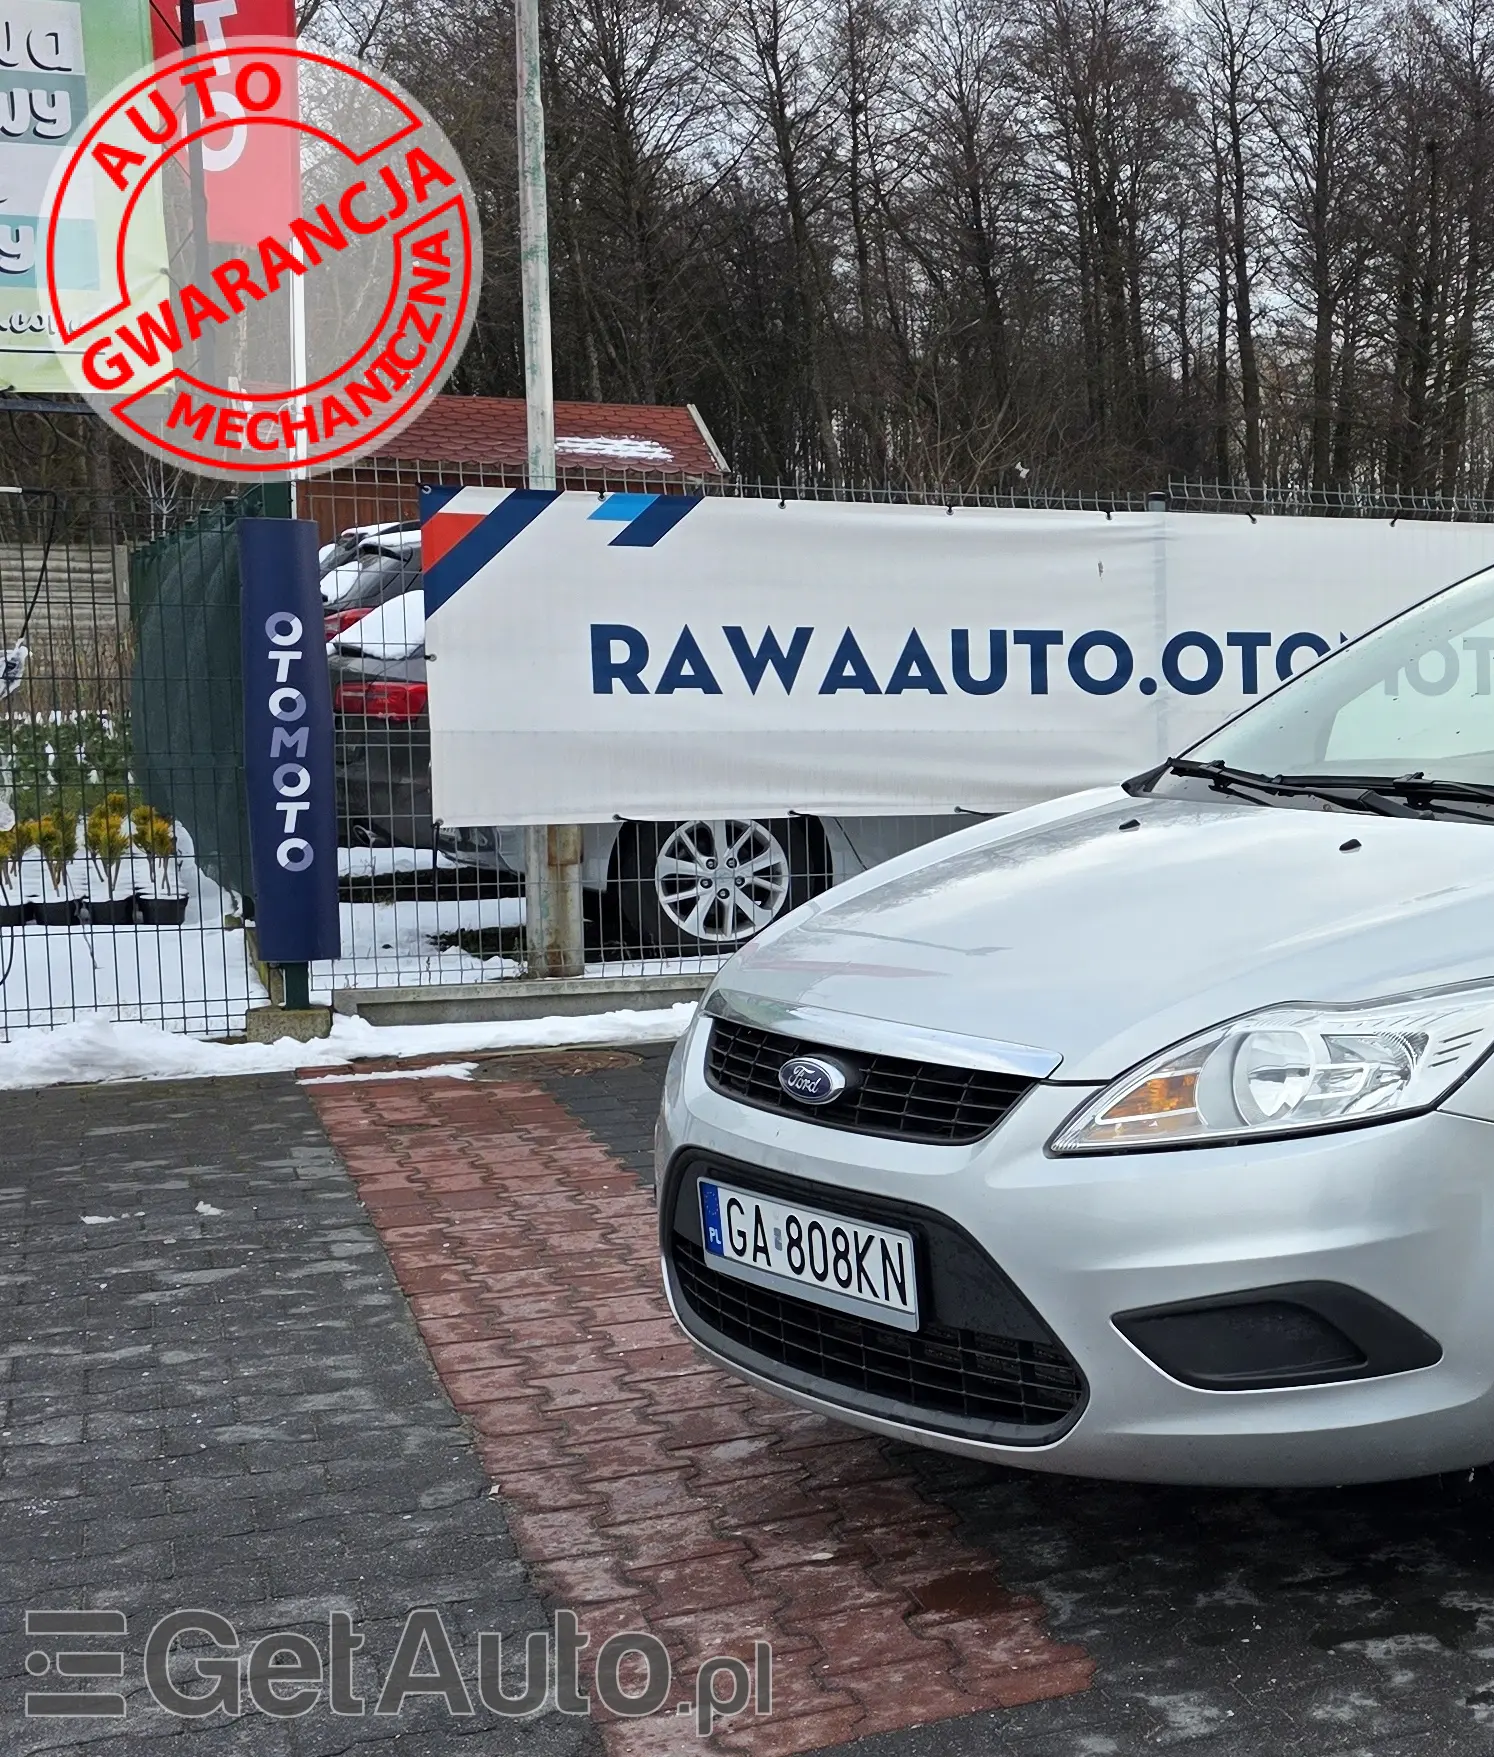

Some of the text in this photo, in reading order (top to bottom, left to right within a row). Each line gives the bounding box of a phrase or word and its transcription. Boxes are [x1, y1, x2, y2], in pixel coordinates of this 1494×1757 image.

[264, 611, 314, 872] OTOMOTO
[788, 1065, 822, 1094] Ford
[708, 1226, 722, 1245] PL
[726, 1198, 908, 1306] GA 808KN
